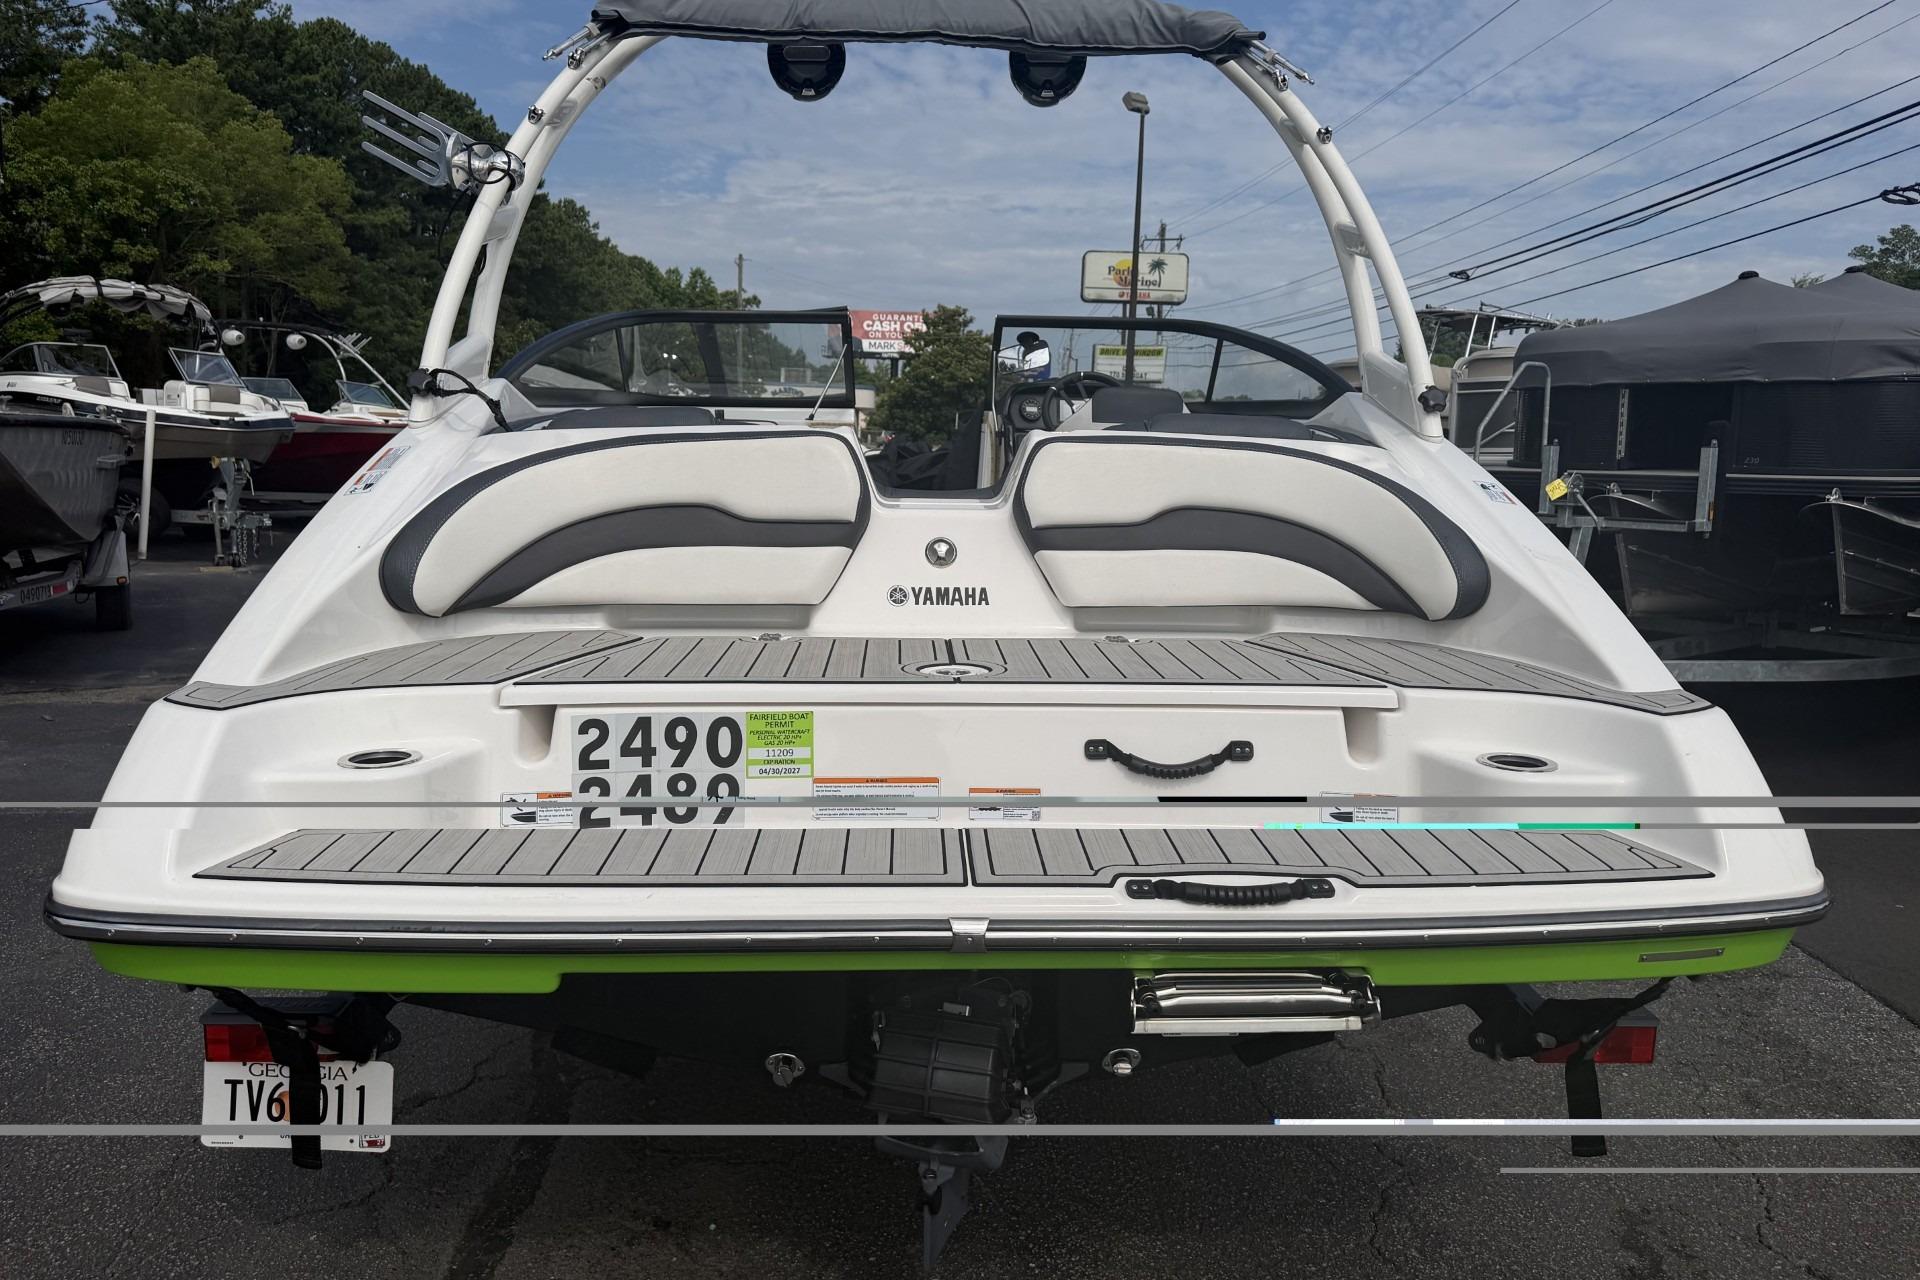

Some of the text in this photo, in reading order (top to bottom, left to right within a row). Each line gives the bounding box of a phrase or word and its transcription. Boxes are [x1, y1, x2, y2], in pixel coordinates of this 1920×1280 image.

[863, 320, 900, 331] CASH
[868, 341, 896, 350] MARK
[911, 587, 990, 606] YAMAHA
[749, 712, 810, 721] FAIRFIELD BOAT
[577, 716, 743, 770] 2490
[765, 749, 794, 757] 11209
[758, 767, 801, 776] 04/30/2027
[578, 772, 740, 829] 2489
[248, 1062, 348, 1081] GEOIA
